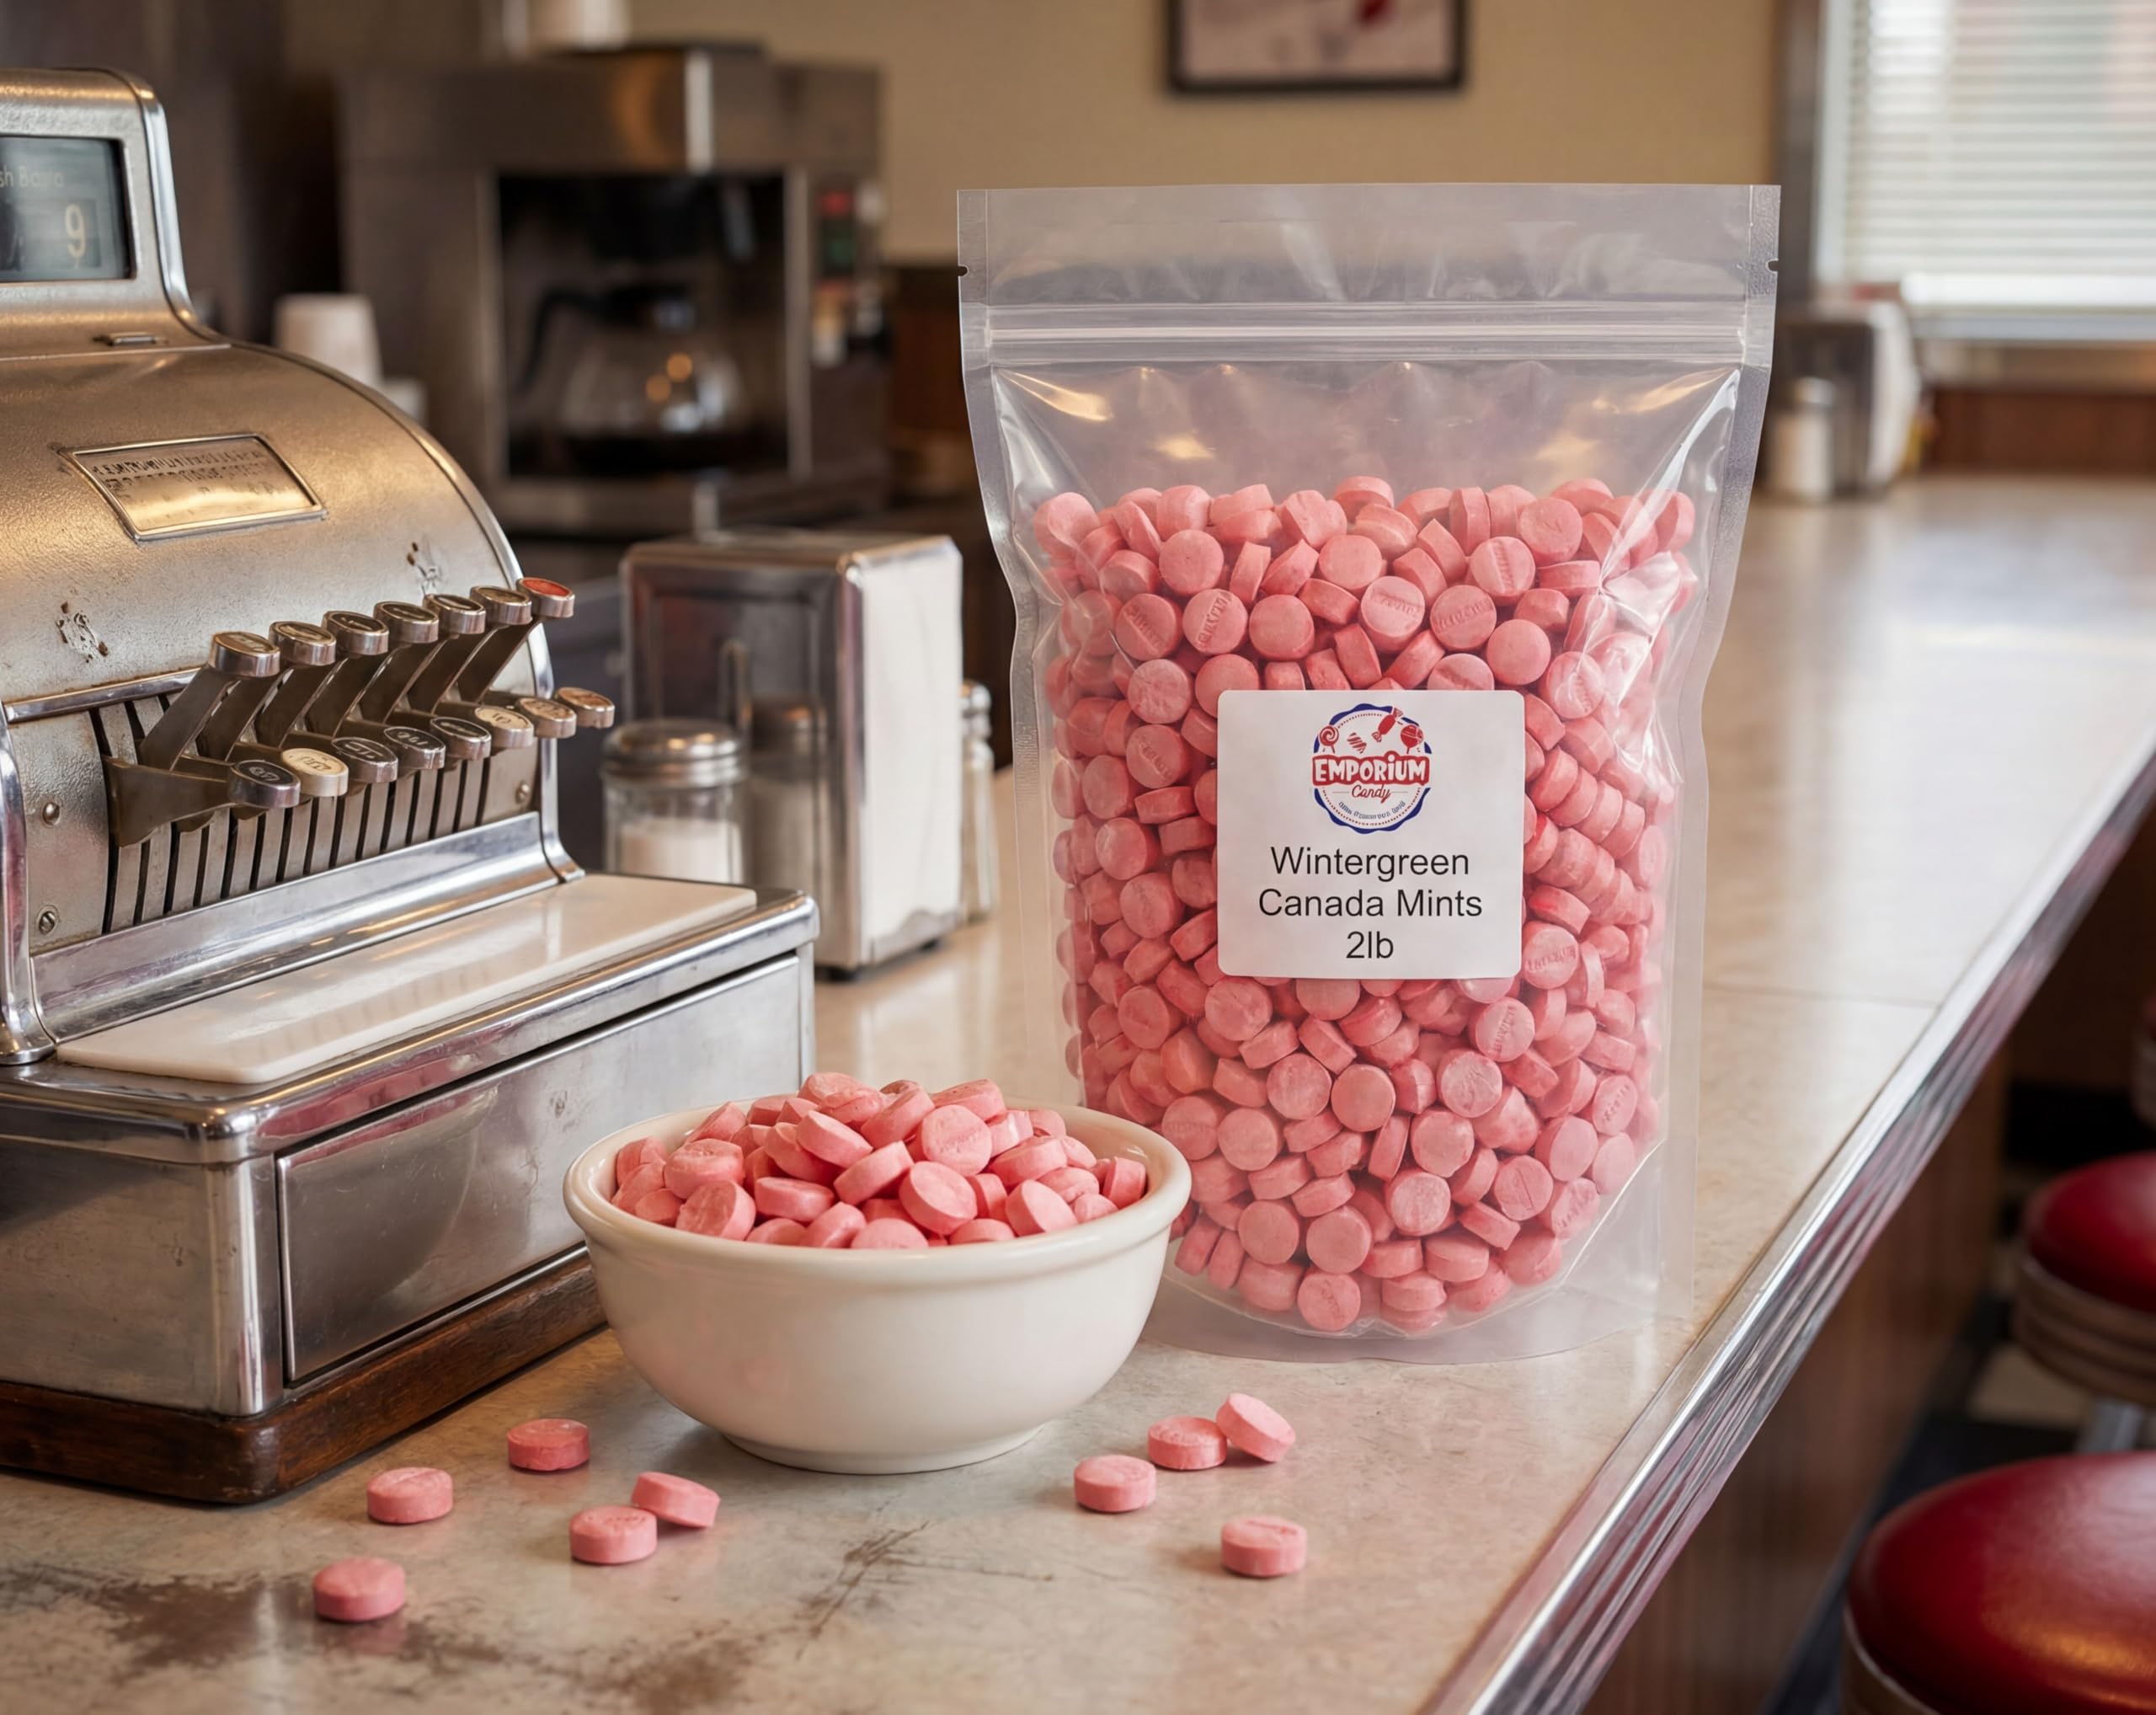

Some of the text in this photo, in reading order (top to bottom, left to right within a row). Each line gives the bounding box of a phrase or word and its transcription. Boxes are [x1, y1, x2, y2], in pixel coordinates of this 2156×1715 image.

[65, 204, 86, 259] 9
[1352, 784, 1392, 804] Candy
[1271, 846, 1470, 882] Wintergreen
[1258, 889, 1483, 916] Canada Mints
[1346, 931, 1395, 959] 2lb
